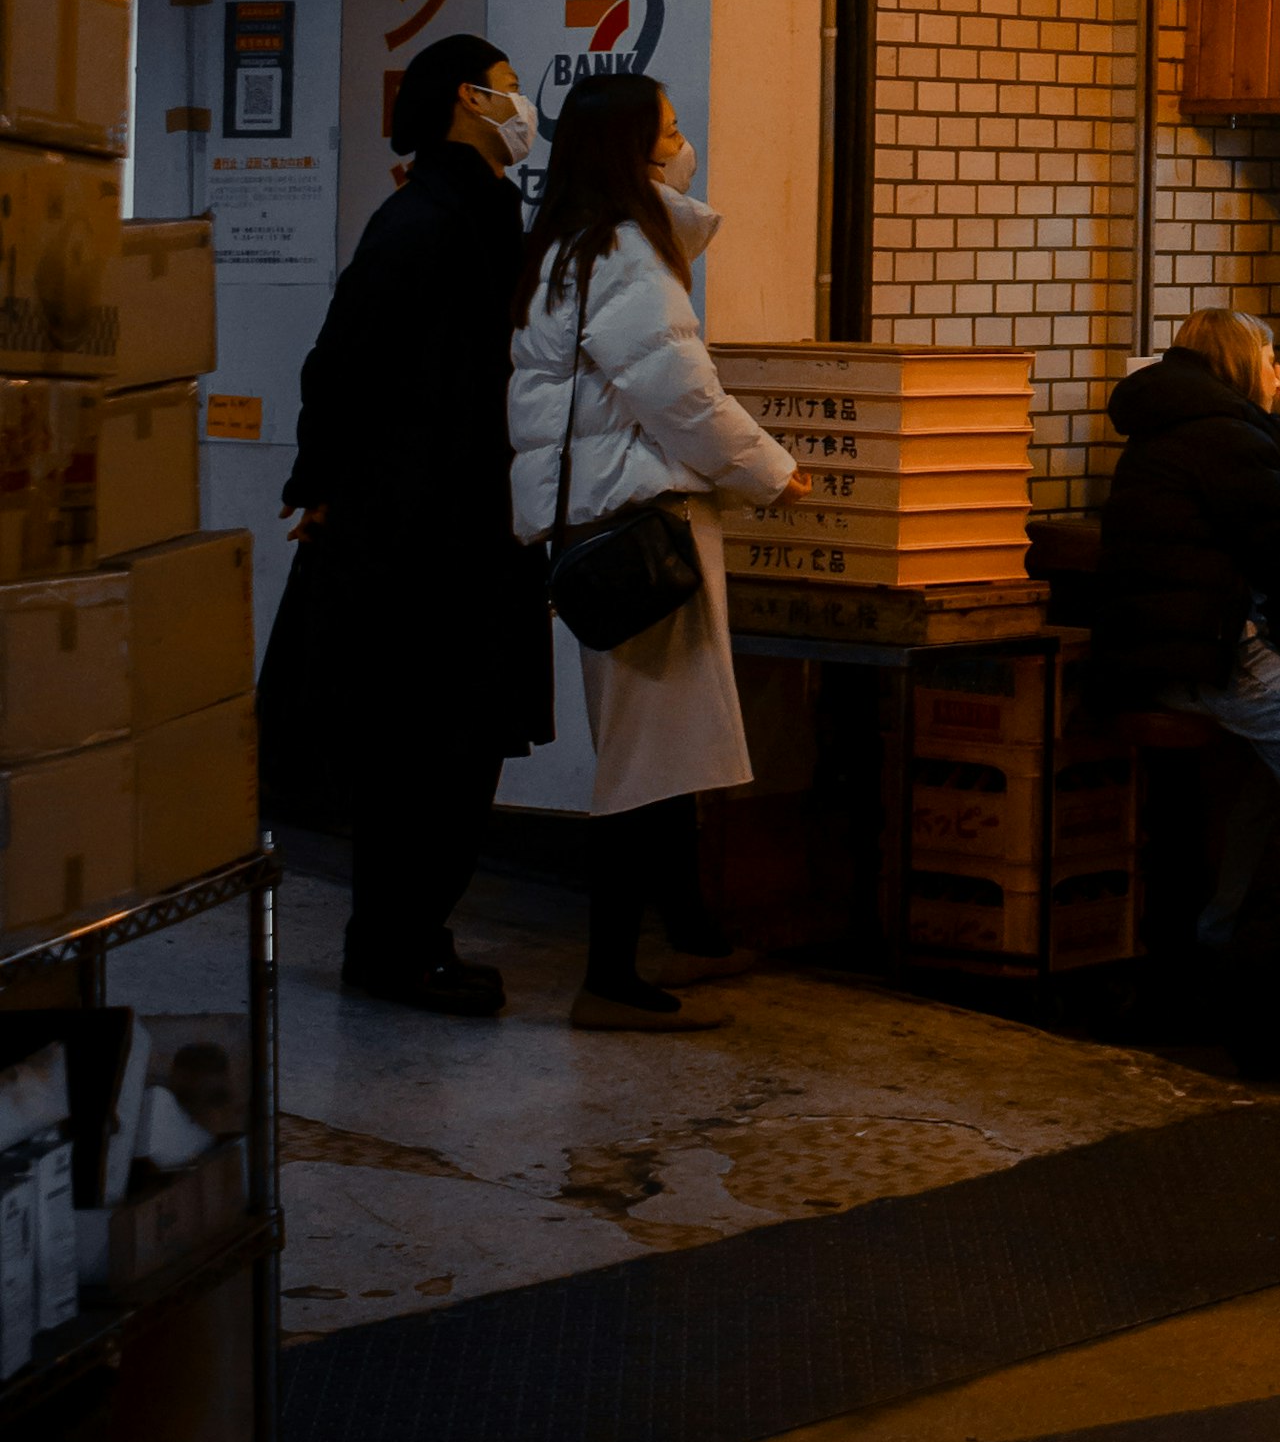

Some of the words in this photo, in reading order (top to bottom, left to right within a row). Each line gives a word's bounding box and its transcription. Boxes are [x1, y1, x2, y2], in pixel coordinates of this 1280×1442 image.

[761, 396, 857, 421] タチバナ食品
